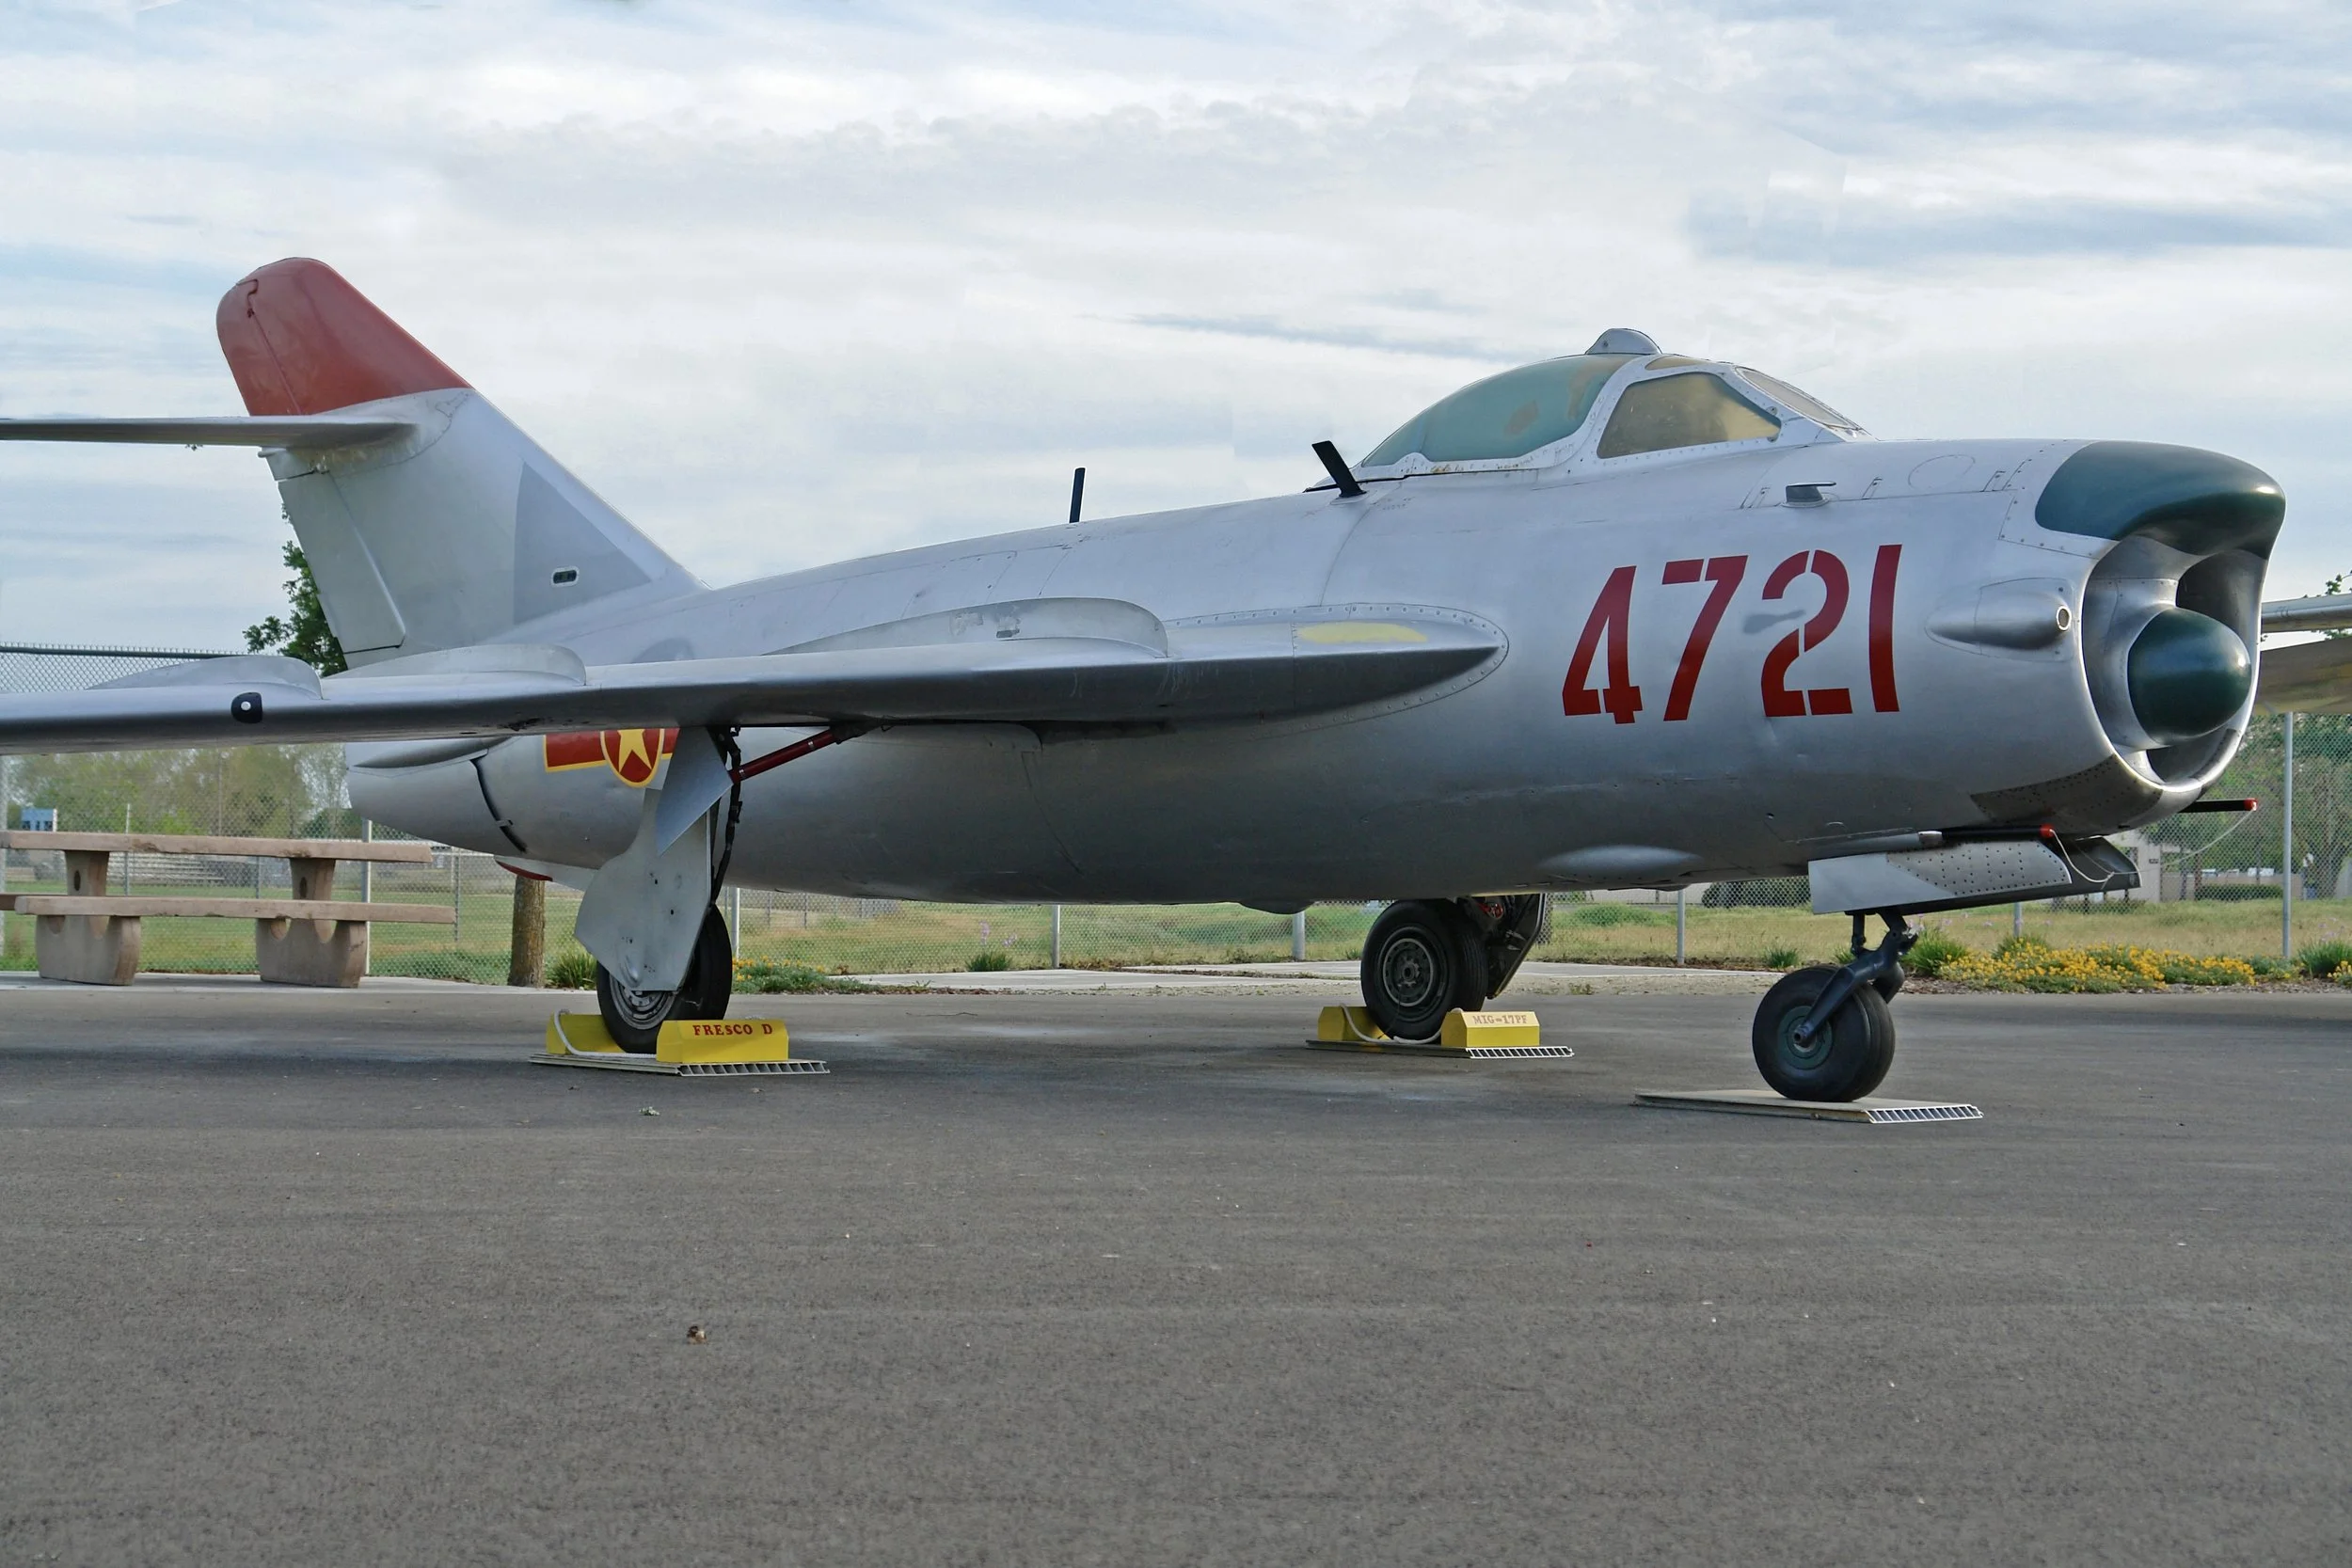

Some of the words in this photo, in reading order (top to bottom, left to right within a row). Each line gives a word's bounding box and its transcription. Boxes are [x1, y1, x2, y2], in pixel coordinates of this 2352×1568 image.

[1562, 544, 1902, 724] 4721
[692, 1023, 753, 1036] FRESCO
[761, 1023, 772, 1035] D
